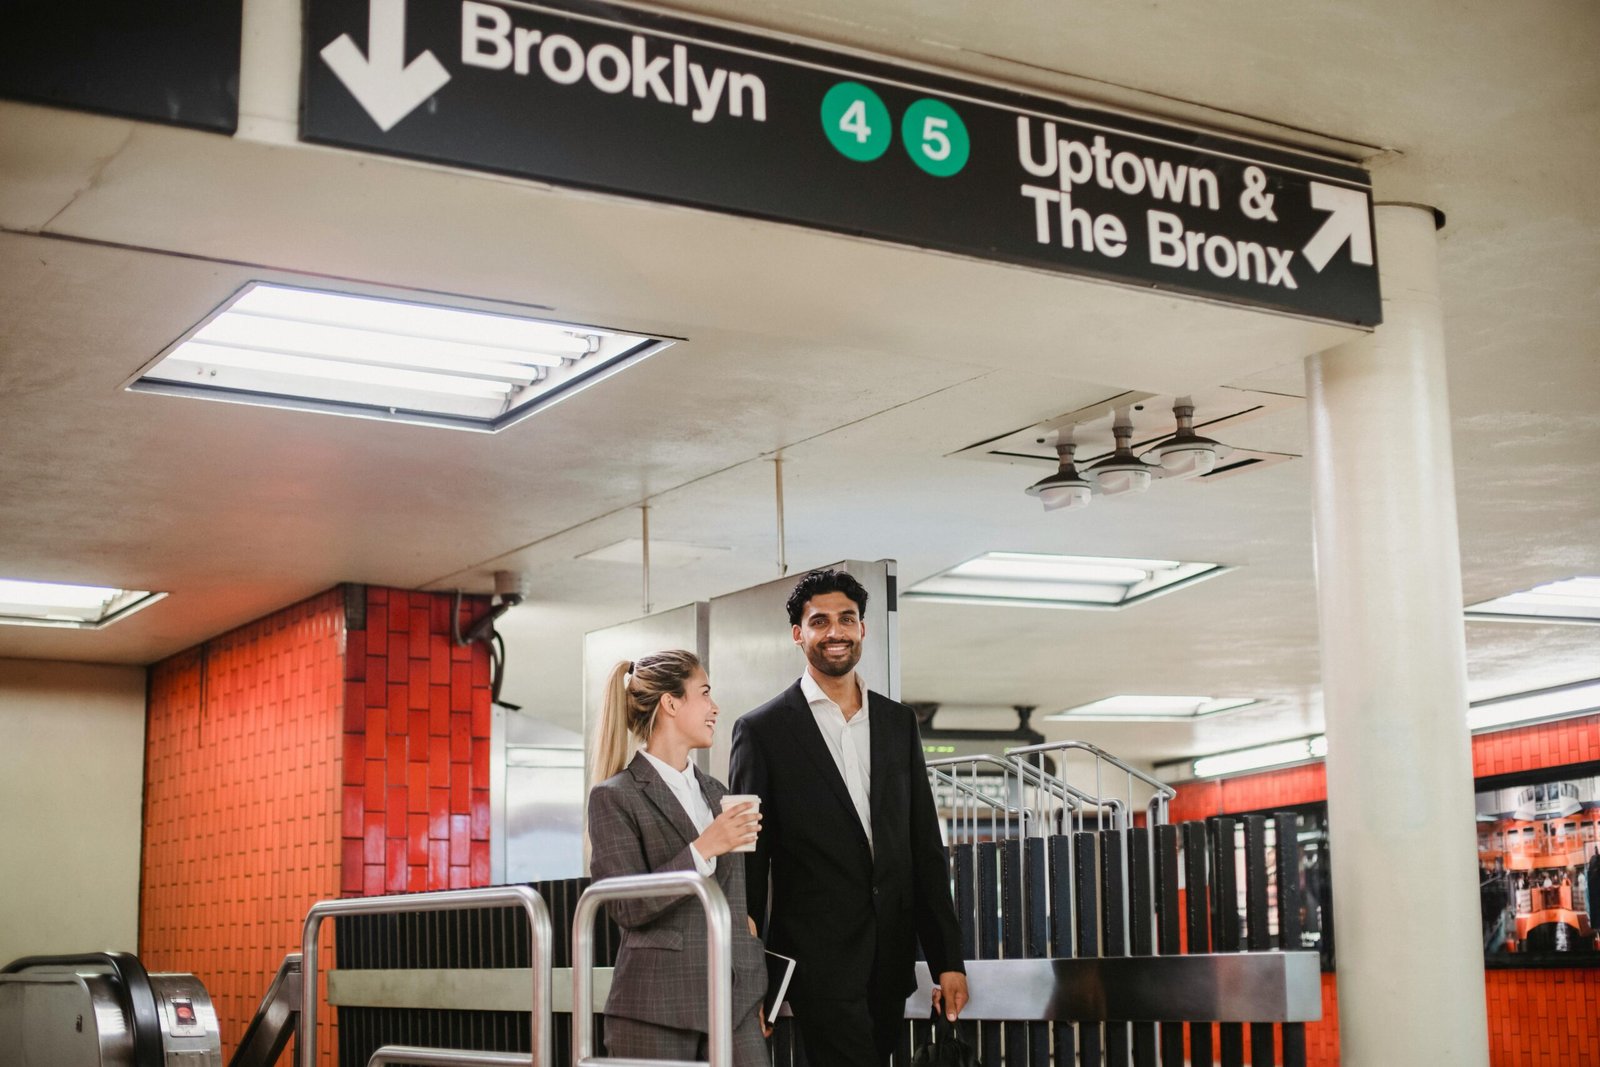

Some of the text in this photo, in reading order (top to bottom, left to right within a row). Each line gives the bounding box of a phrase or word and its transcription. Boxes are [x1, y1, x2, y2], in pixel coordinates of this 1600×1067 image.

[461, 1, 767, 123] Brooklyn
[839, 99, 952, 161] 4 5
[1017, 116, 1278, 222] Uptown &
[1021, 184, 1298, 290] The Bronx
